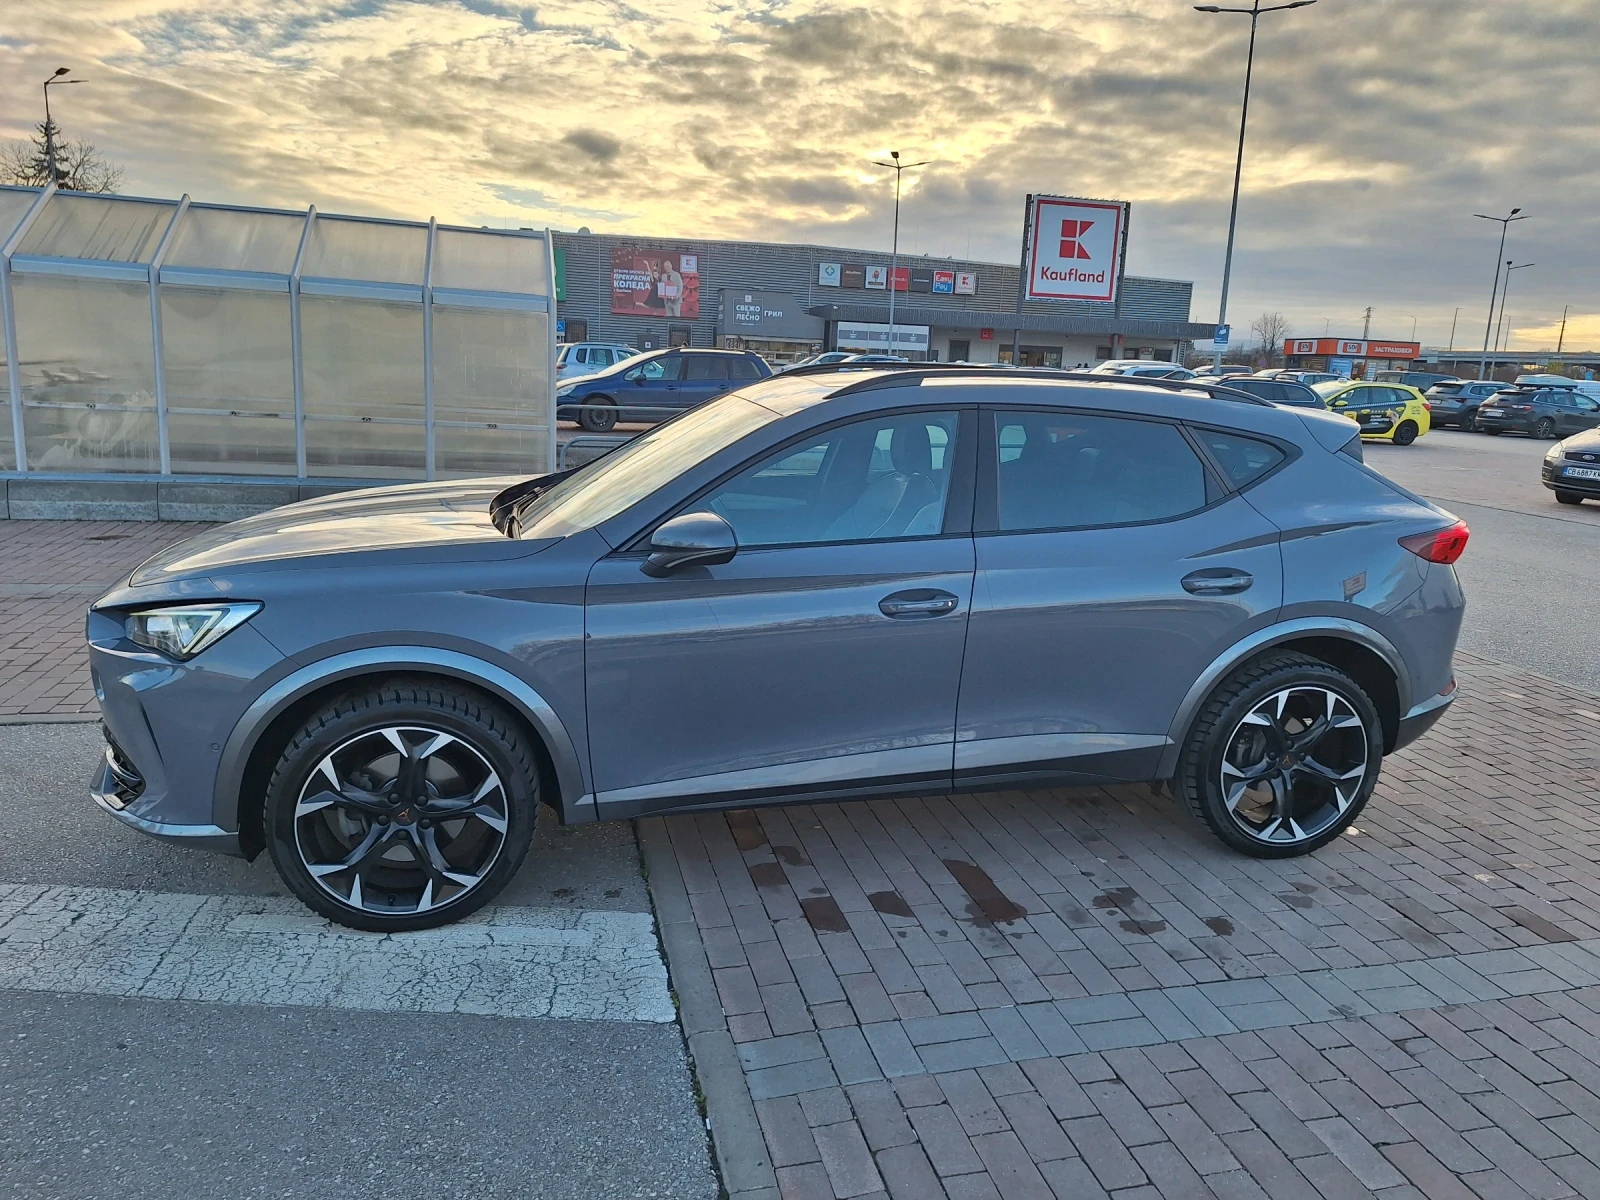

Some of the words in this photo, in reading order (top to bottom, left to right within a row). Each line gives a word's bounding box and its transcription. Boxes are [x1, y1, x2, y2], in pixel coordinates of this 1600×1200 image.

[613, 273, 651, 282] ПРЕКРАСНА
[936, 274, 952, 284] Easy
[1040, 266, 1105, 284] Kaufland
[613, 280, 651, 290] КОЛЕДА
[935, 282, 948, 291] Pay
[736, 304, 761, 312] СВЕЖО
[736, 313, 760, 321] ЛЕСНО
[764, 310, 783, 318] ГРИЛ
